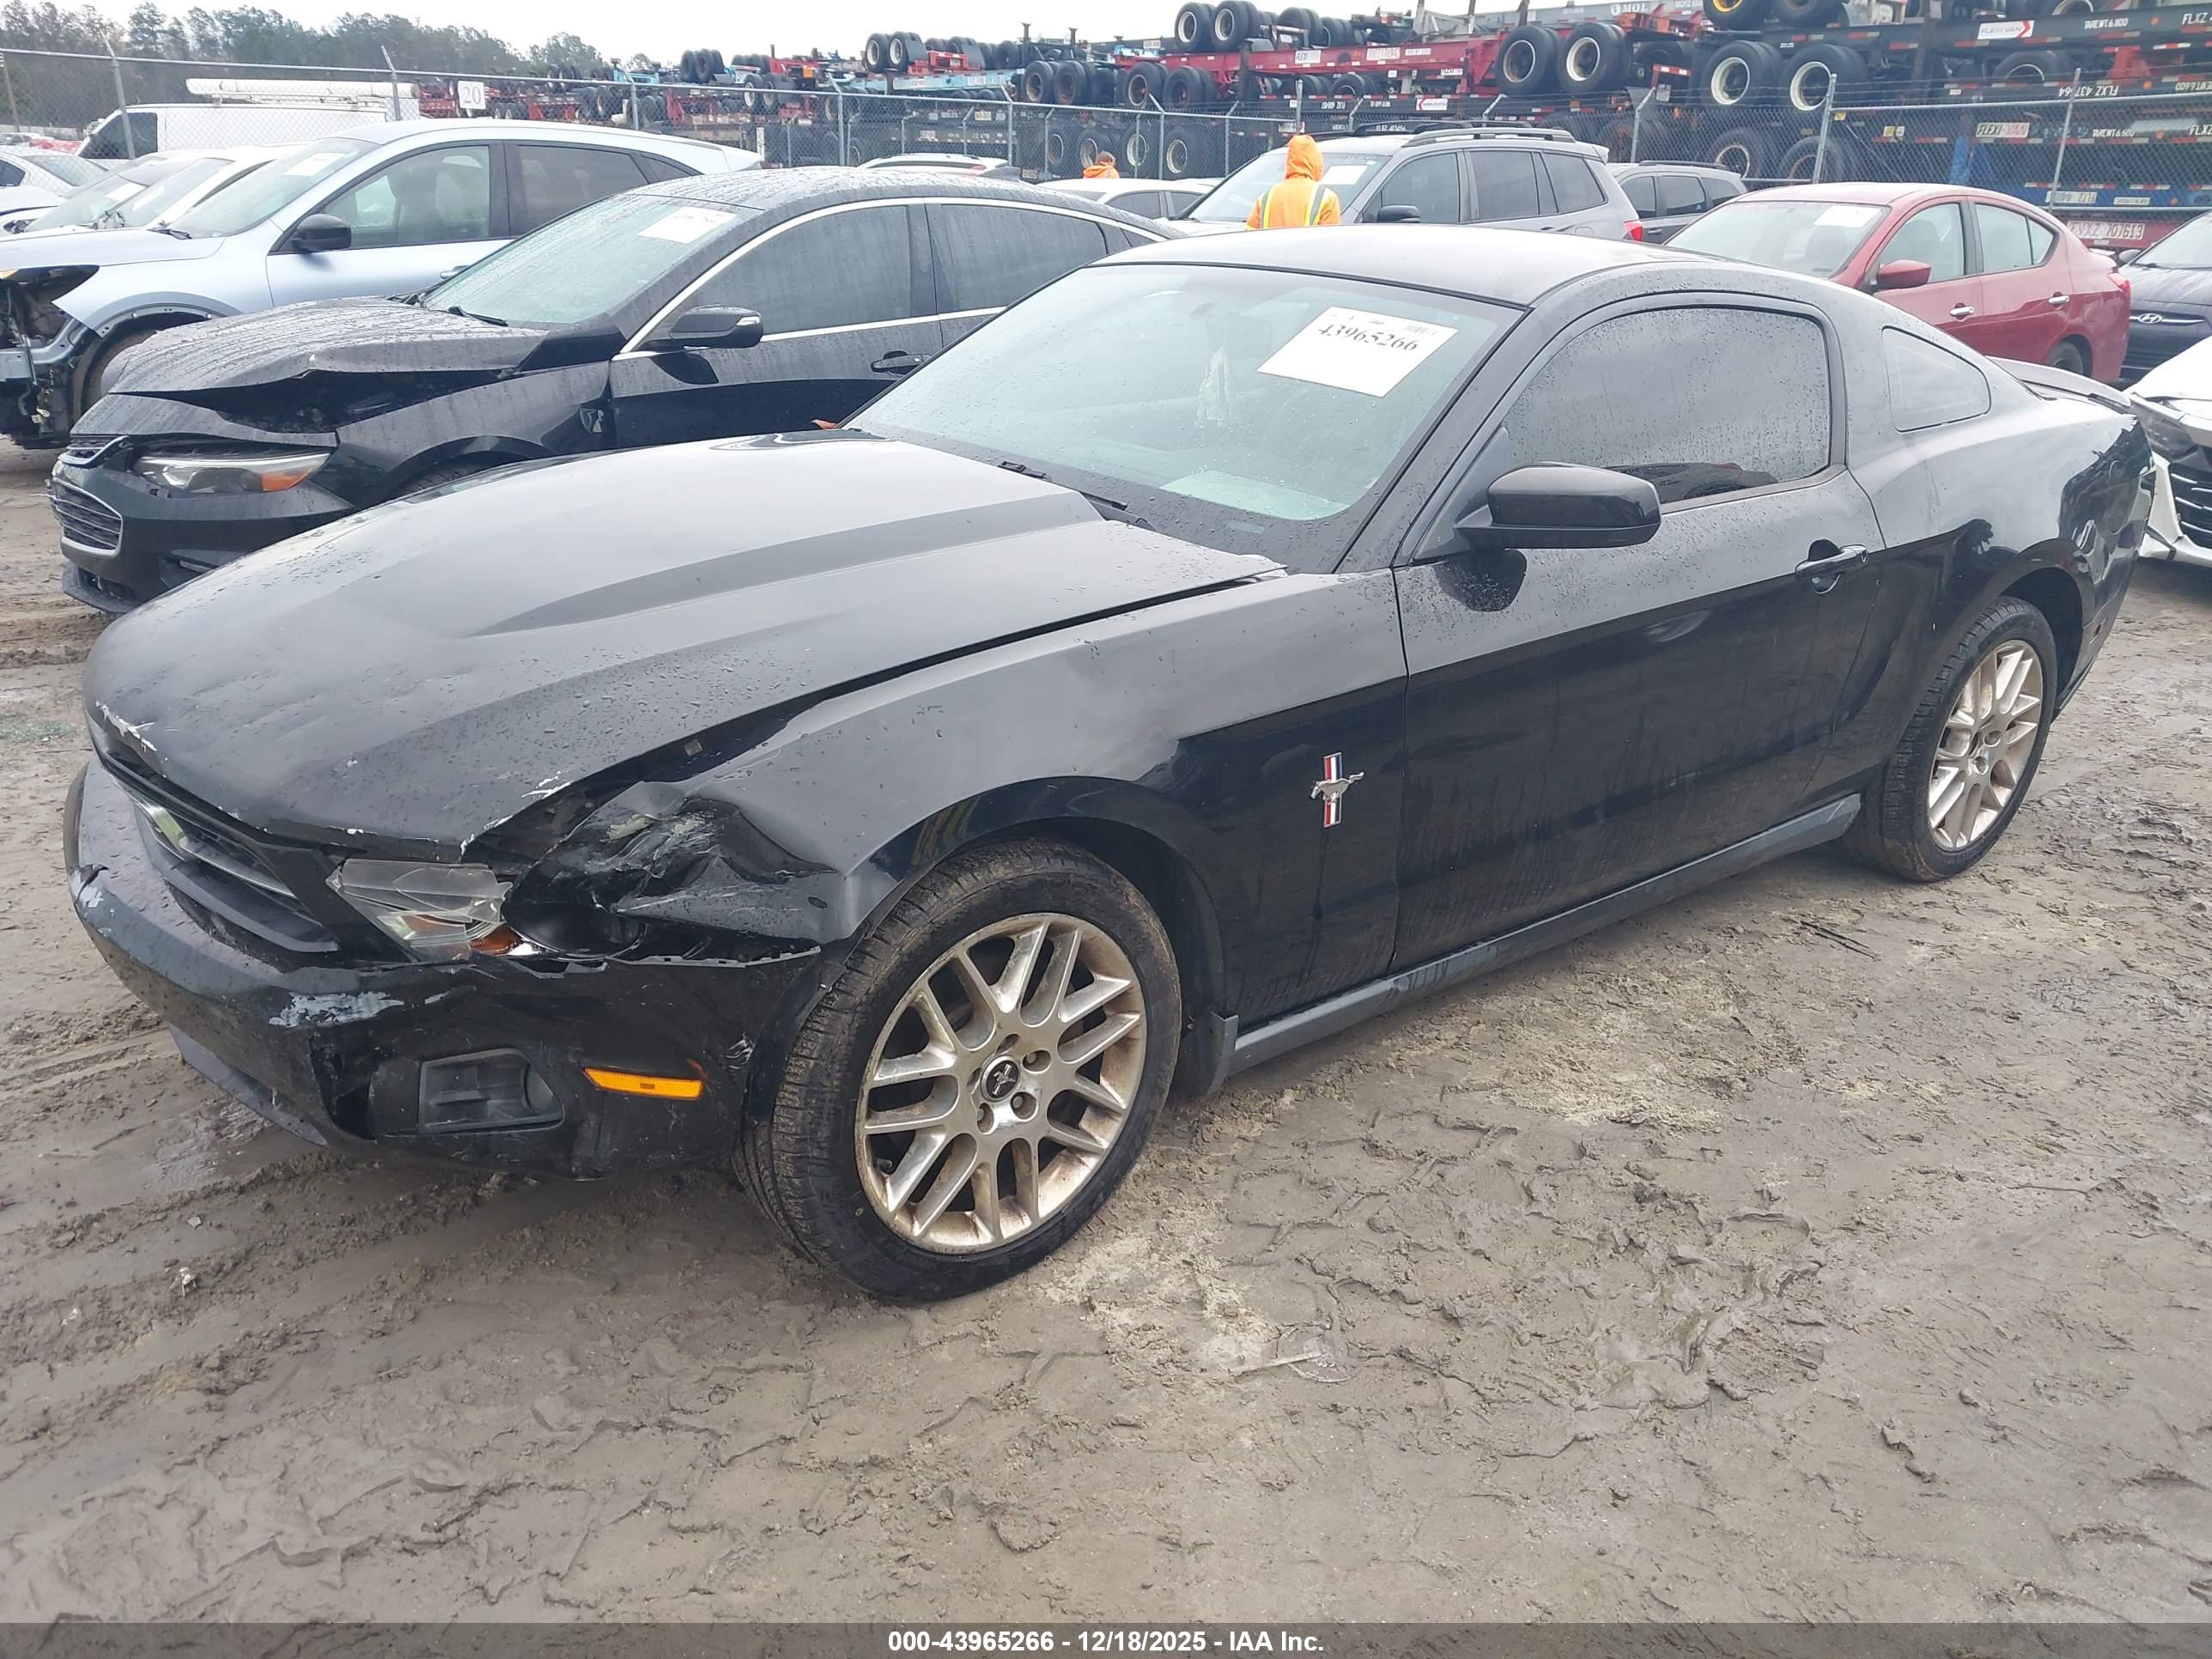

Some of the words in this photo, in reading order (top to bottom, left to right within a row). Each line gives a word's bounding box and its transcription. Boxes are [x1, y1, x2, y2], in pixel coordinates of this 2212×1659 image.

[1622, 3, 1648, 13] MOL
[2182, 12, 2208, 25] FLXZ
[463, 86, 482, 105] 20
[2058, 86, 2093, 97] 43764
[2095, 85, 2118, 96] FLXZ
[1318, 323, 1419, 351] 43965266
